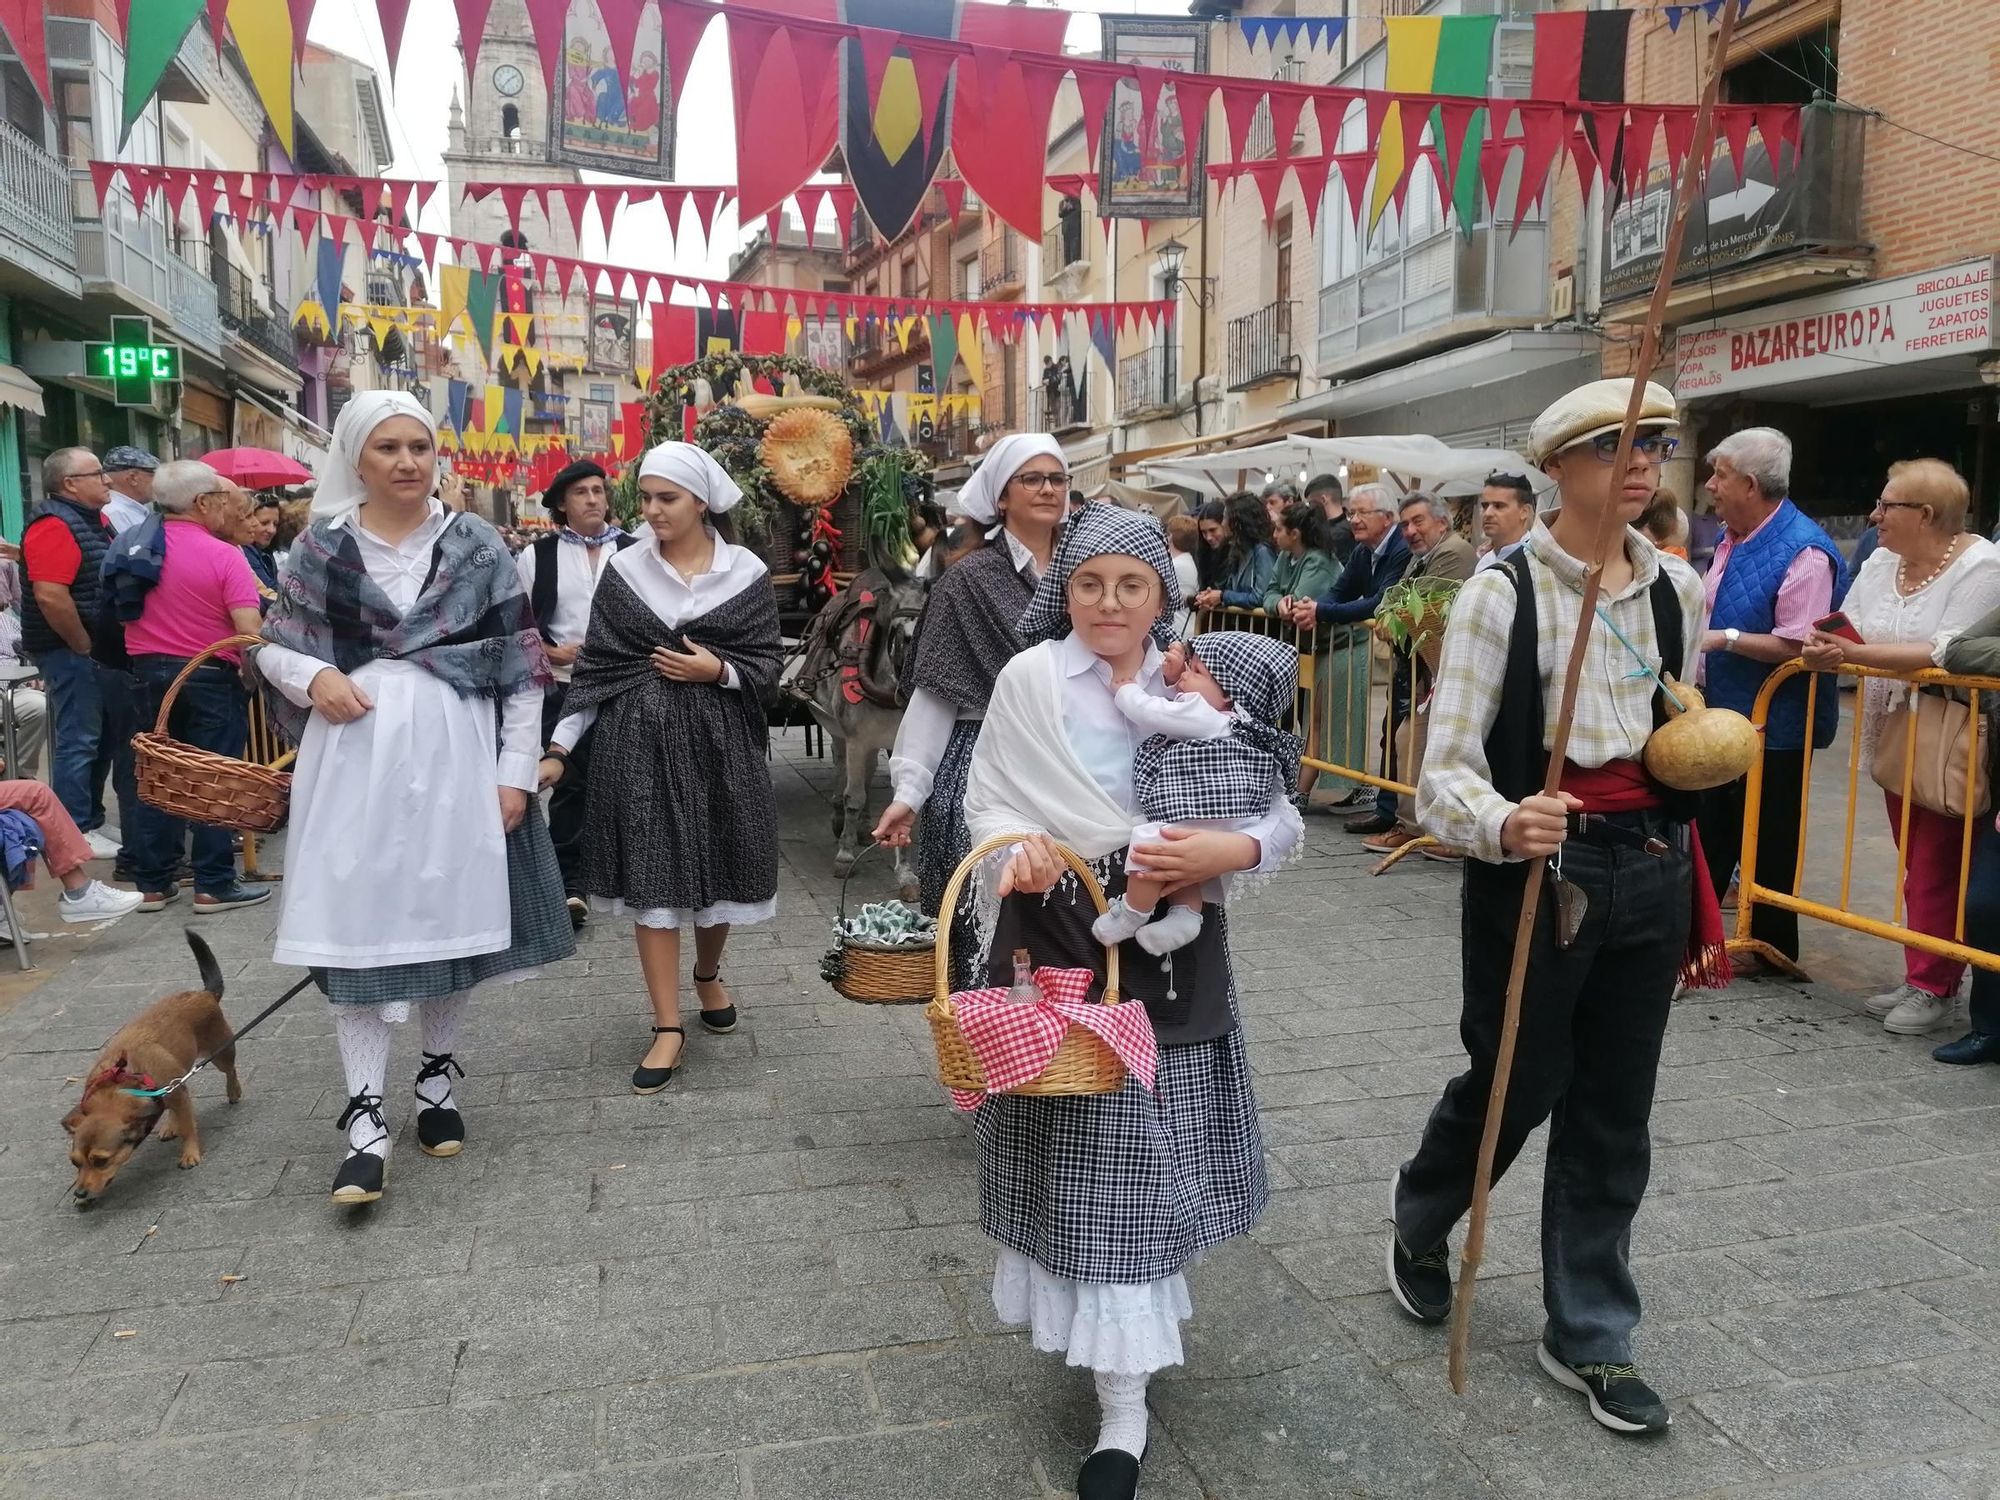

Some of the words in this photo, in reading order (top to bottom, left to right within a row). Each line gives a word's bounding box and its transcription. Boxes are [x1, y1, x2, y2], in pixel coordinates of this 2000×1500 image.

[1710, 241, 1719, 251] de
[1720, 238, 1729, 247] La
[1730, 227, 1758, 245] Merced
[1916, 268, 1989, 295] BRICOLAJE
[1918, 288, 1989, 313] JUGUETES
[1928, 307, 1988, 330] ZAPATOS
[1905, 325, 1988, 351] FERRETERÍA
[1680, 344, 1717, 361] BOLSOS
[1680, 361, 1704, 375] ROPA
[1679, 373, 1722, 390] REGALOS
